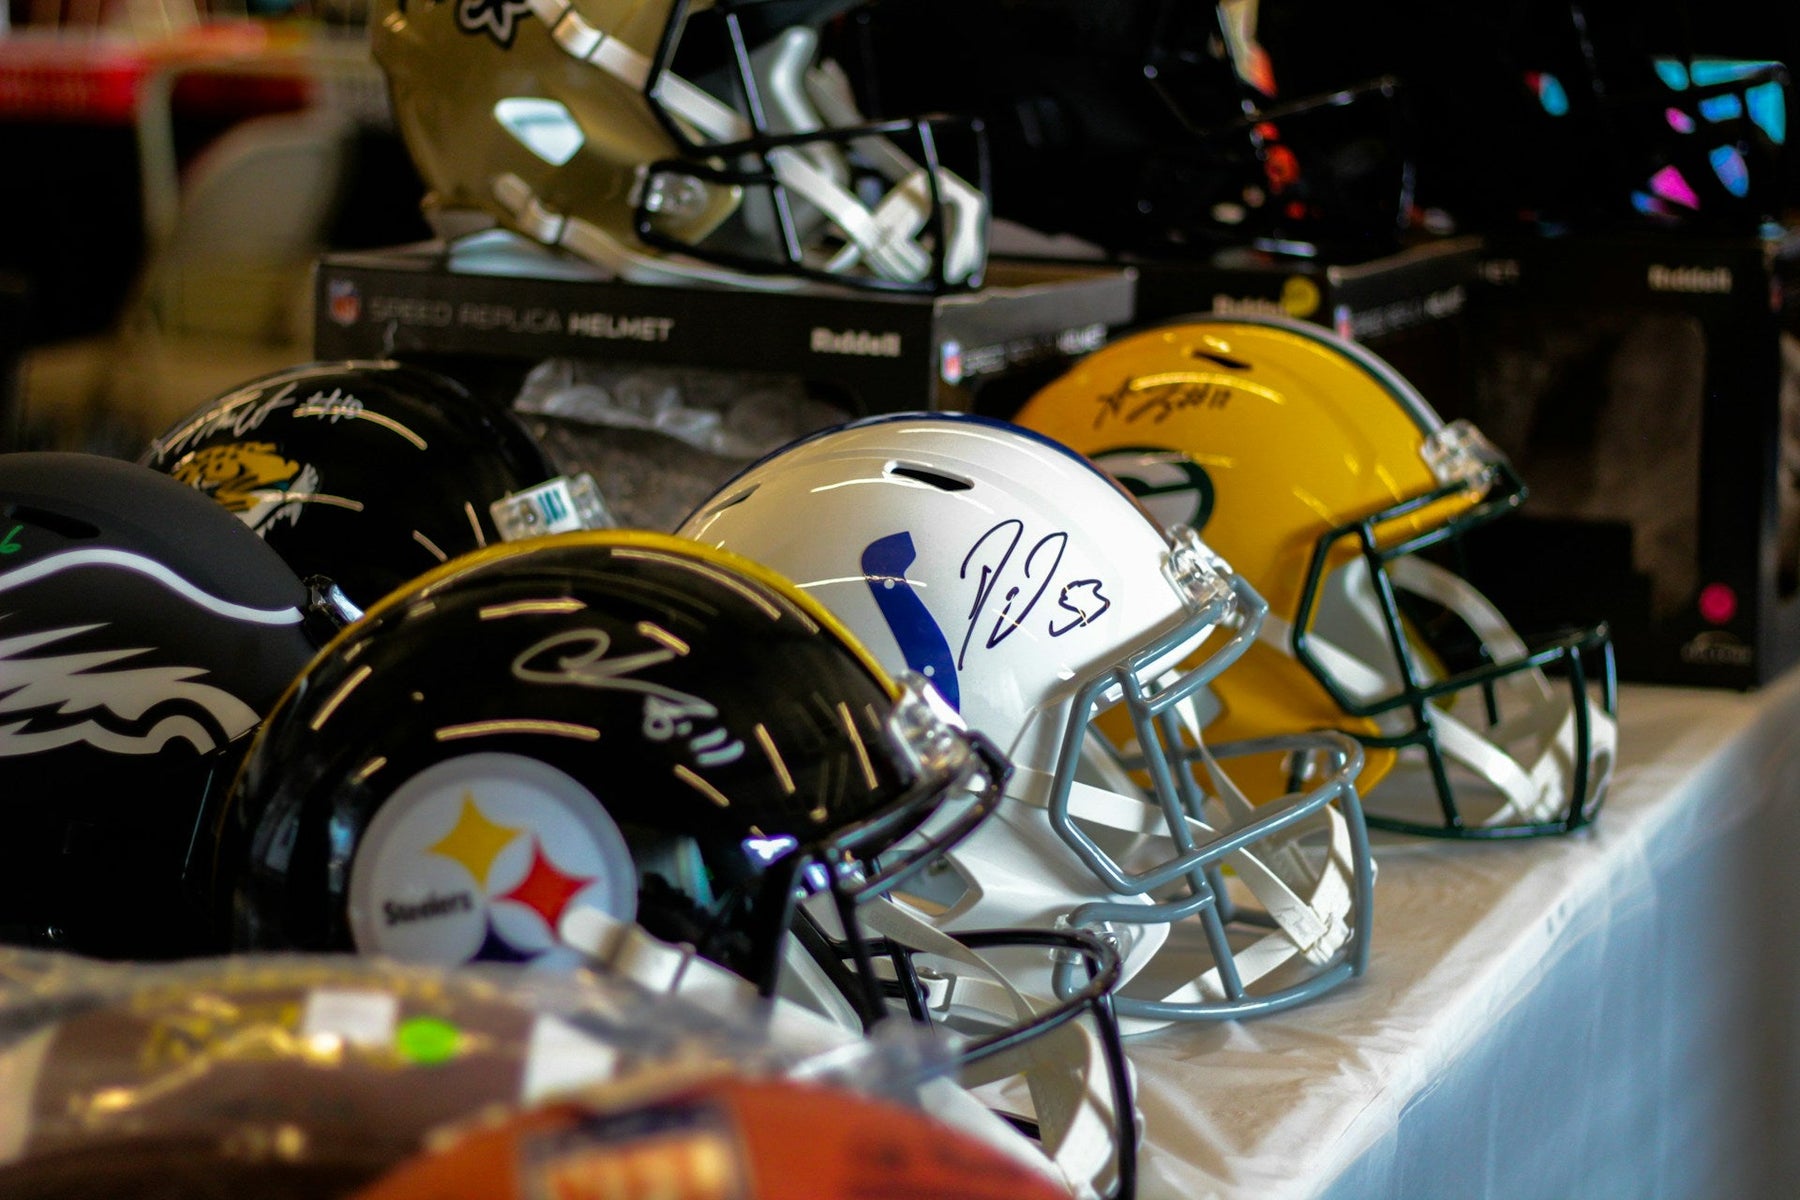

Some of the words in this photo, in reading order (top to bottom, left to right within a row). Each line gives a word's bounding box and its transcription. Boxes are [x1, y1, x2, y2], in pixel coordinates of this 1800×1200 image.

[457, 302, 563, 334] REPLICA
[567, 311, 675, 342] HELMET
[810, 326, 902, 357] Riddell
[1049, 579, 1110, 638] 53
[383, 889, 473, 927] Steelers
